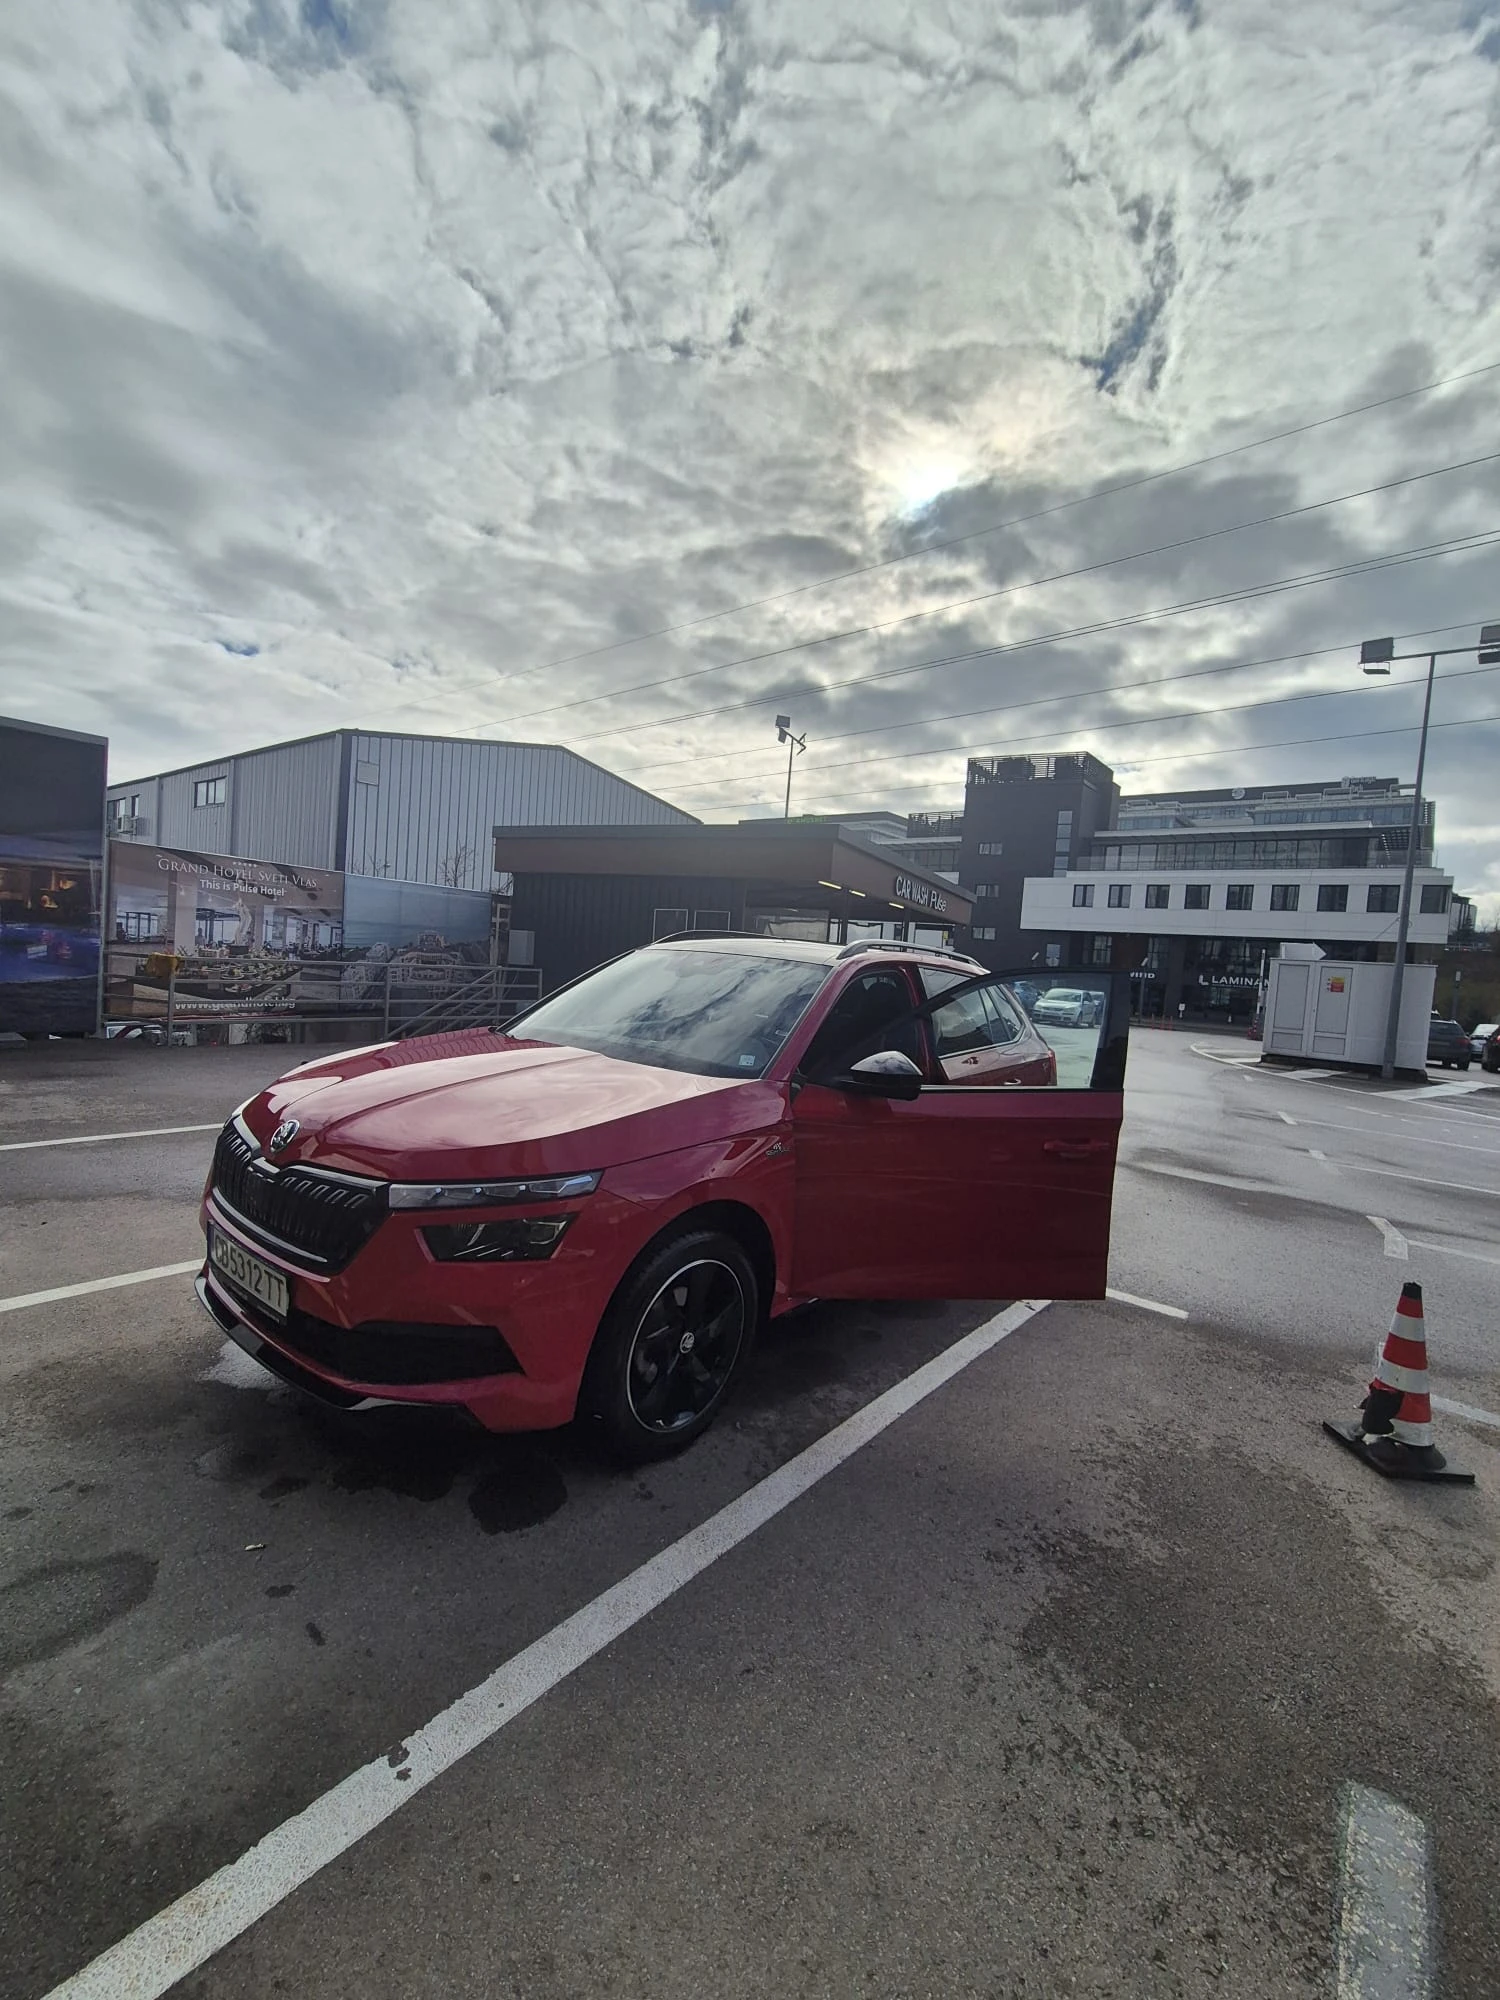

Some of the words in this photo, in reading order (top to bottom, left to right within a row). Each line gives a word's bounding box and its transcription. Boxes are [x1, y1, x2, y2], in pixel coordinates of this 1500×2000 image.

[158, 858, 209, 875] GRAND
[213, 864, 253, 880] HOTEL
[258, 870, 288, 884] SVETI
[292, 874, 318, 888] VLAS
[200, 879, 221, 891] This
[223, 881, 231, 891] is
[233, 882, 258, 894] Pulse
[260, 886, 285, 897] Hotel
[896, 875, 911, 900] CAR
[912, 880, 929, 907] WASH
[930, 890, 947, 912] Pulse
